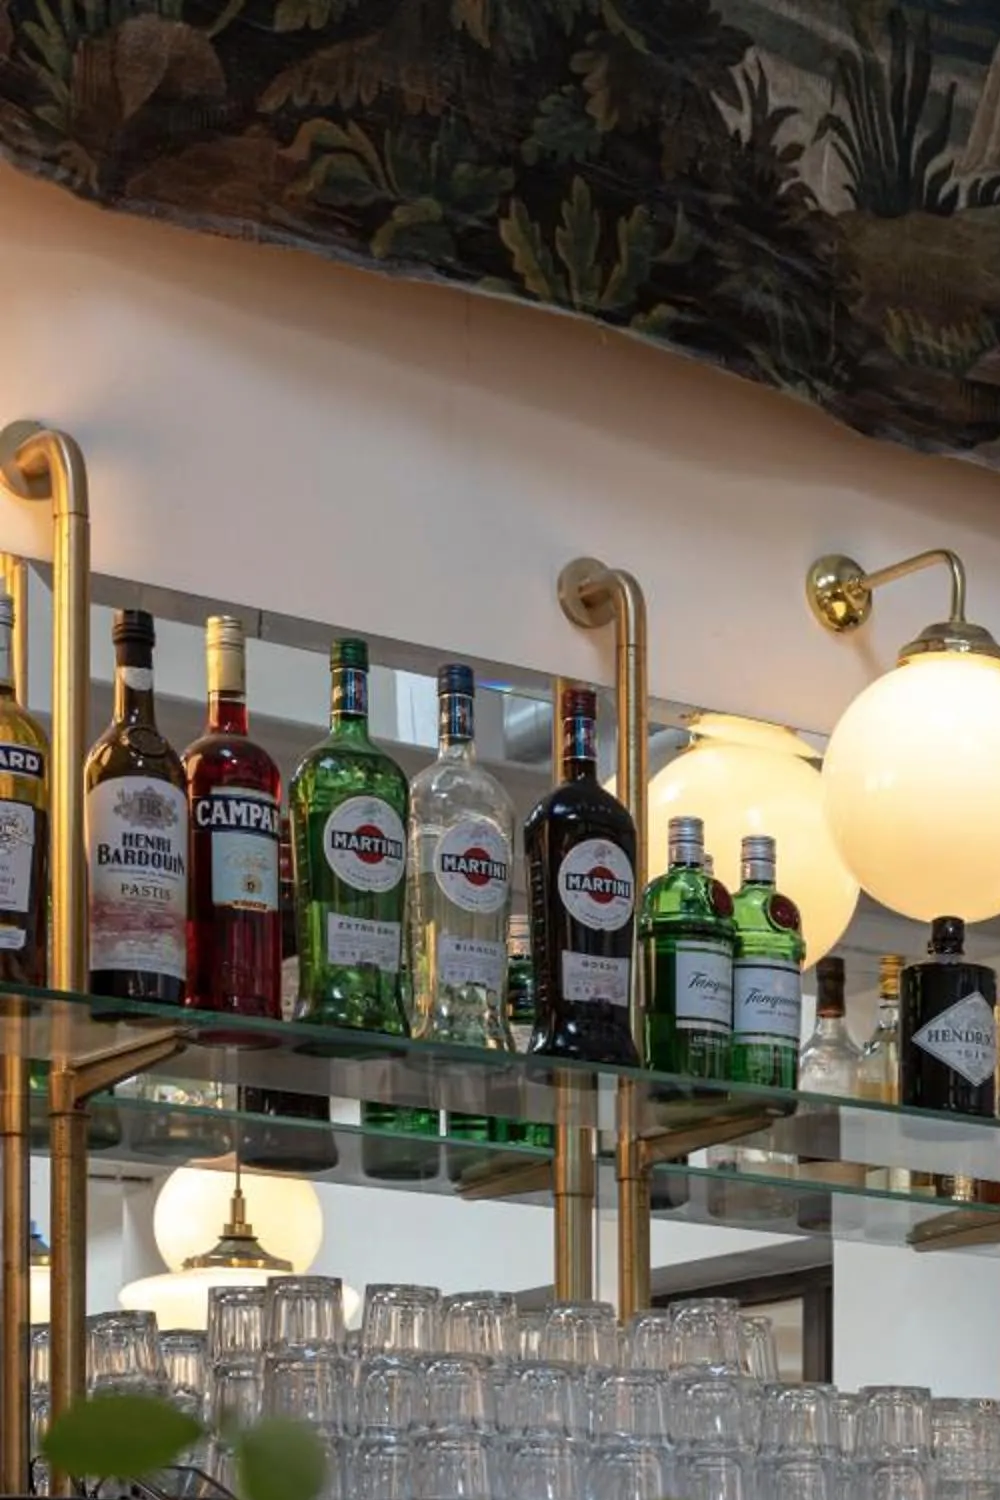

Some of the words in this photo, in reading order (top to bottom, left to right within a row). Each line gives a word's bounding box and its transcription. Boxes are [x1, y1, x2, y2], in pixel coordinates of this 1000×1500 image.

[121, 832, 171, 853] HENRI
[334, 832, 402, 861] MARTINI
[443, 854, 507, 881] MARTINI
[568, 875, 630, 898] MARTINI
